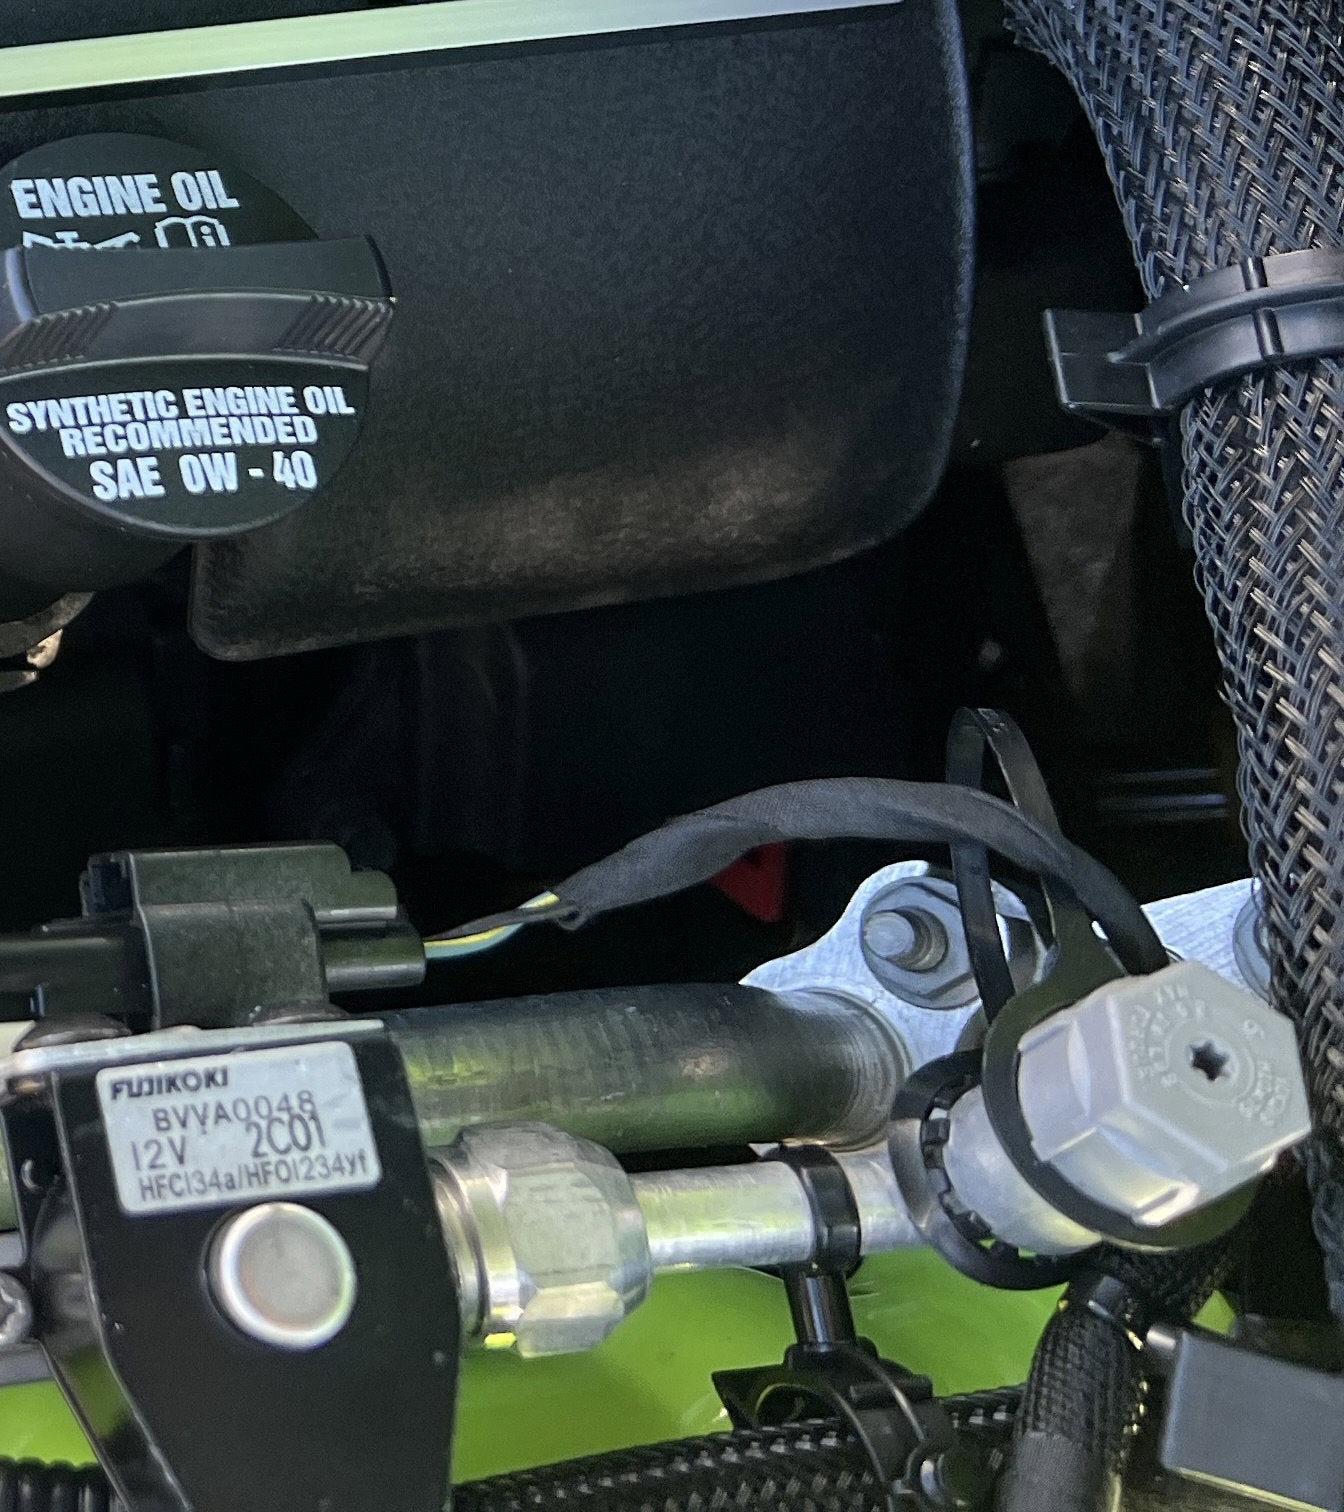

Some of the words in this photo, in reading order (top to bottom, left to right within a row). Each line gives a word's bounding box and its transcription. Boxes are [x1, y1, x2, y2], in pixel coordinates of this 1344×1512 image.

[10, 173, 167, 219] ENGINE
[170, 169, 240, 211] OIL
[6, 388, 180, 434] SYNTHETIC
[180, 386, 299, 419] ENGINE
[302, 385, 355, 416] OIL
[58, 415, 318, 459] RECOMMENDED
[88, 456, 165, 502] SAE
[178, 451, 238, 494] 0W
[271, 450, 318, 490] 40
[112, 1065, 230, 1100] FUJIKOKI
[152, 1090, 317, 1132] BVVA0048
[131, 1135, 188, 1172] 12V
